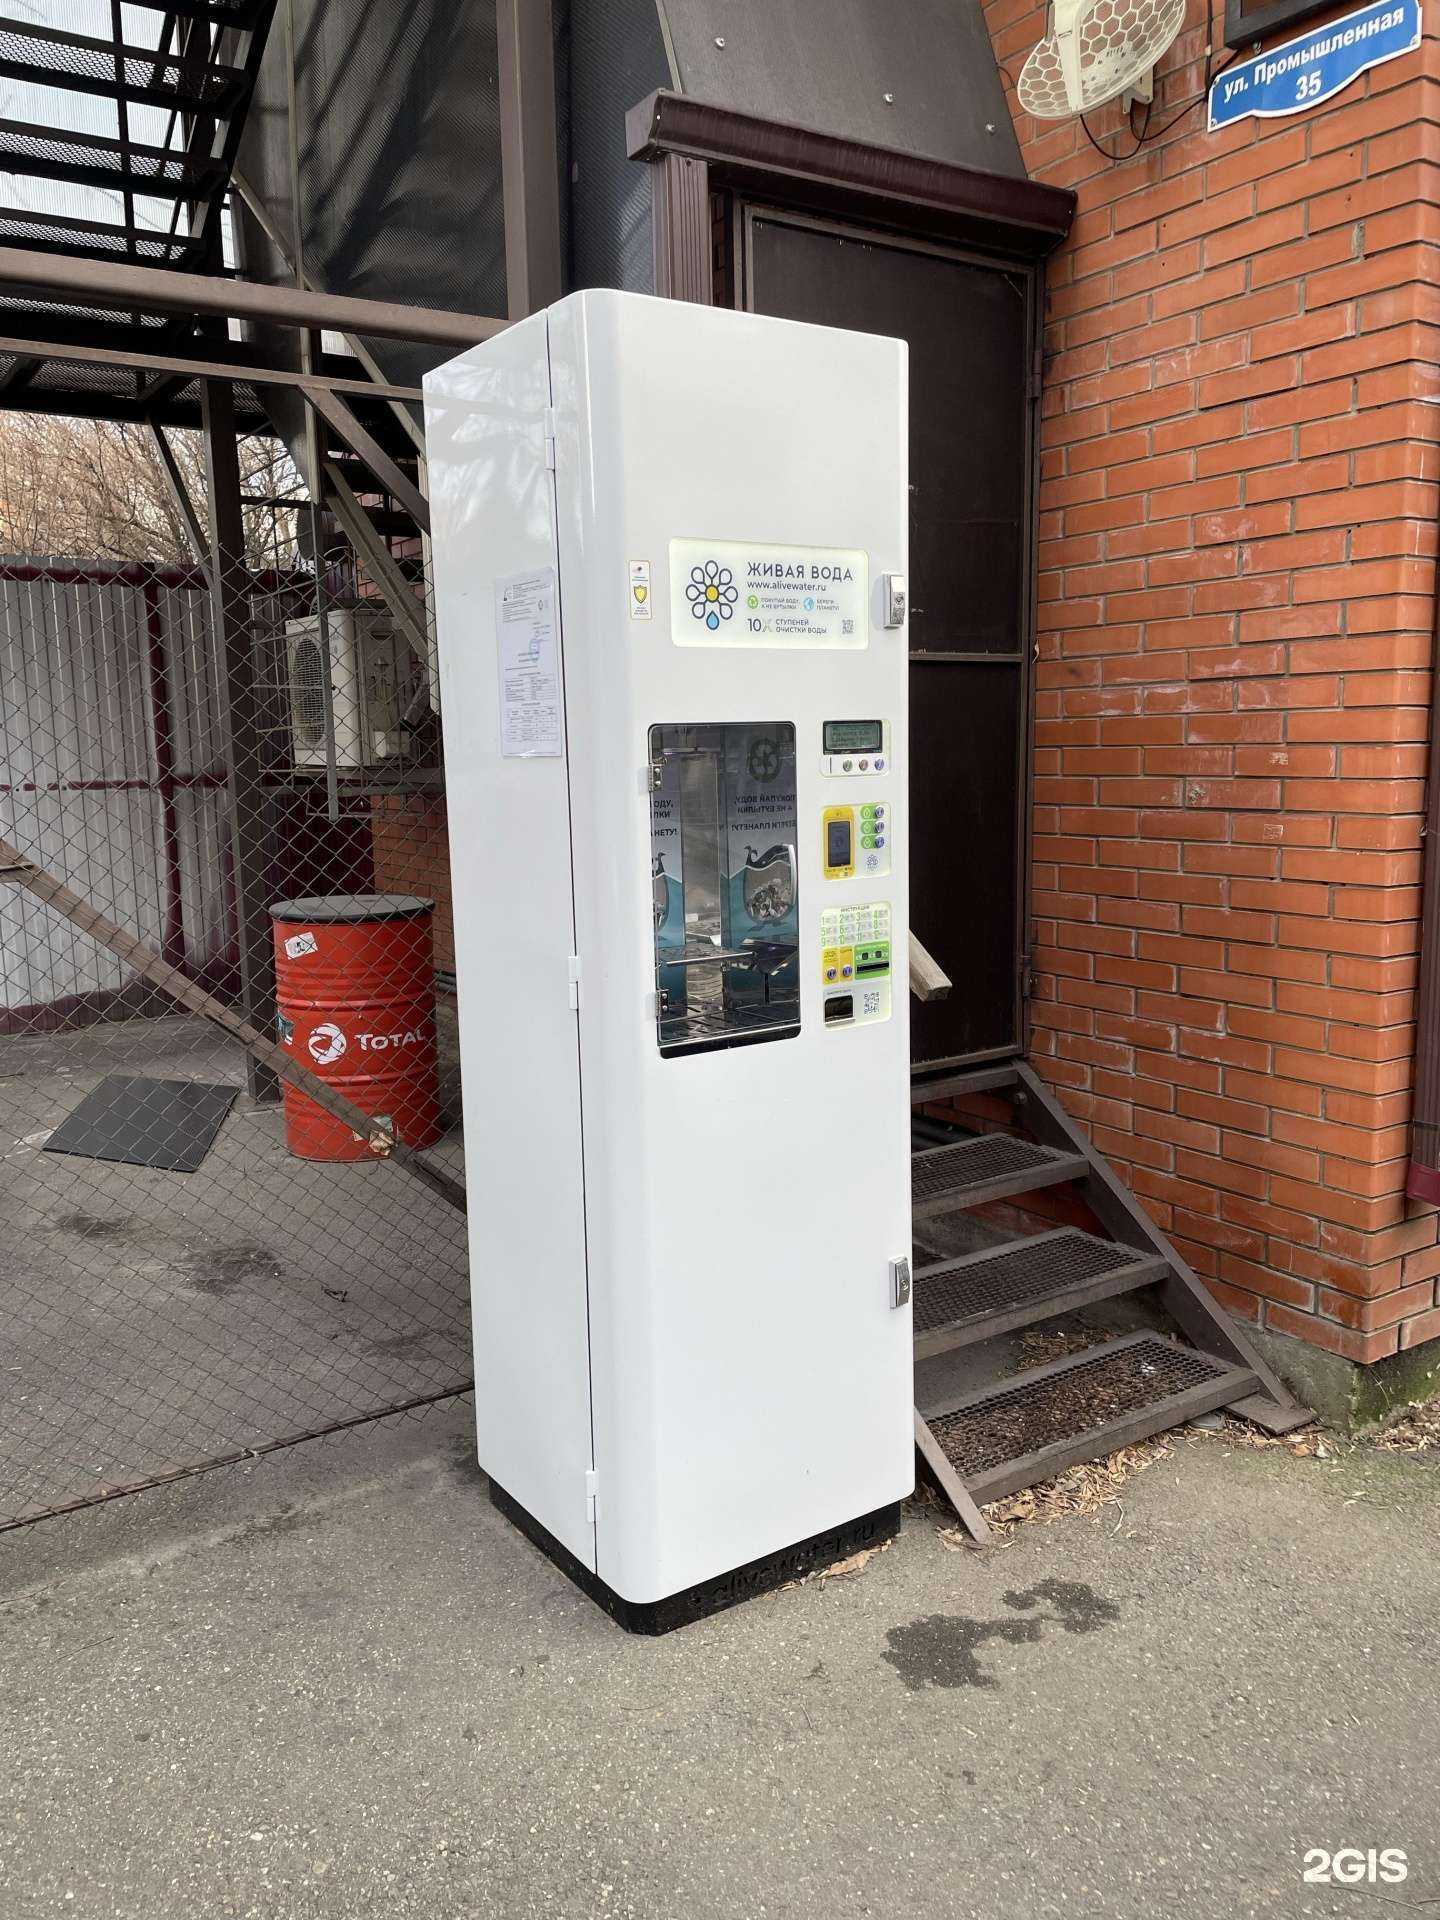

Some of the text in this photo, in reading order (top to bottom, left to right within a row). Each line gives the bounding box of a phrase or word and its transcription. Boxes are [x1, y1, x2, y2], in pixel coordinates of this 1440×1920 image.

[1224, 6, 1405, 103] ул. Промышленная
[1295, 70, 1322, 101] 35
[747, 562, 853, 582] ЖИВАЯ ВОДА
[747, 580, 826, 592] www.alivewater.ru
[775, 618, 809, 626] СТУПЕНЕЙ
[775, 626, 827, 635] ОЧИСТКИ ВОДЫ
[354, 1029, 427, 1051] TOTAL
